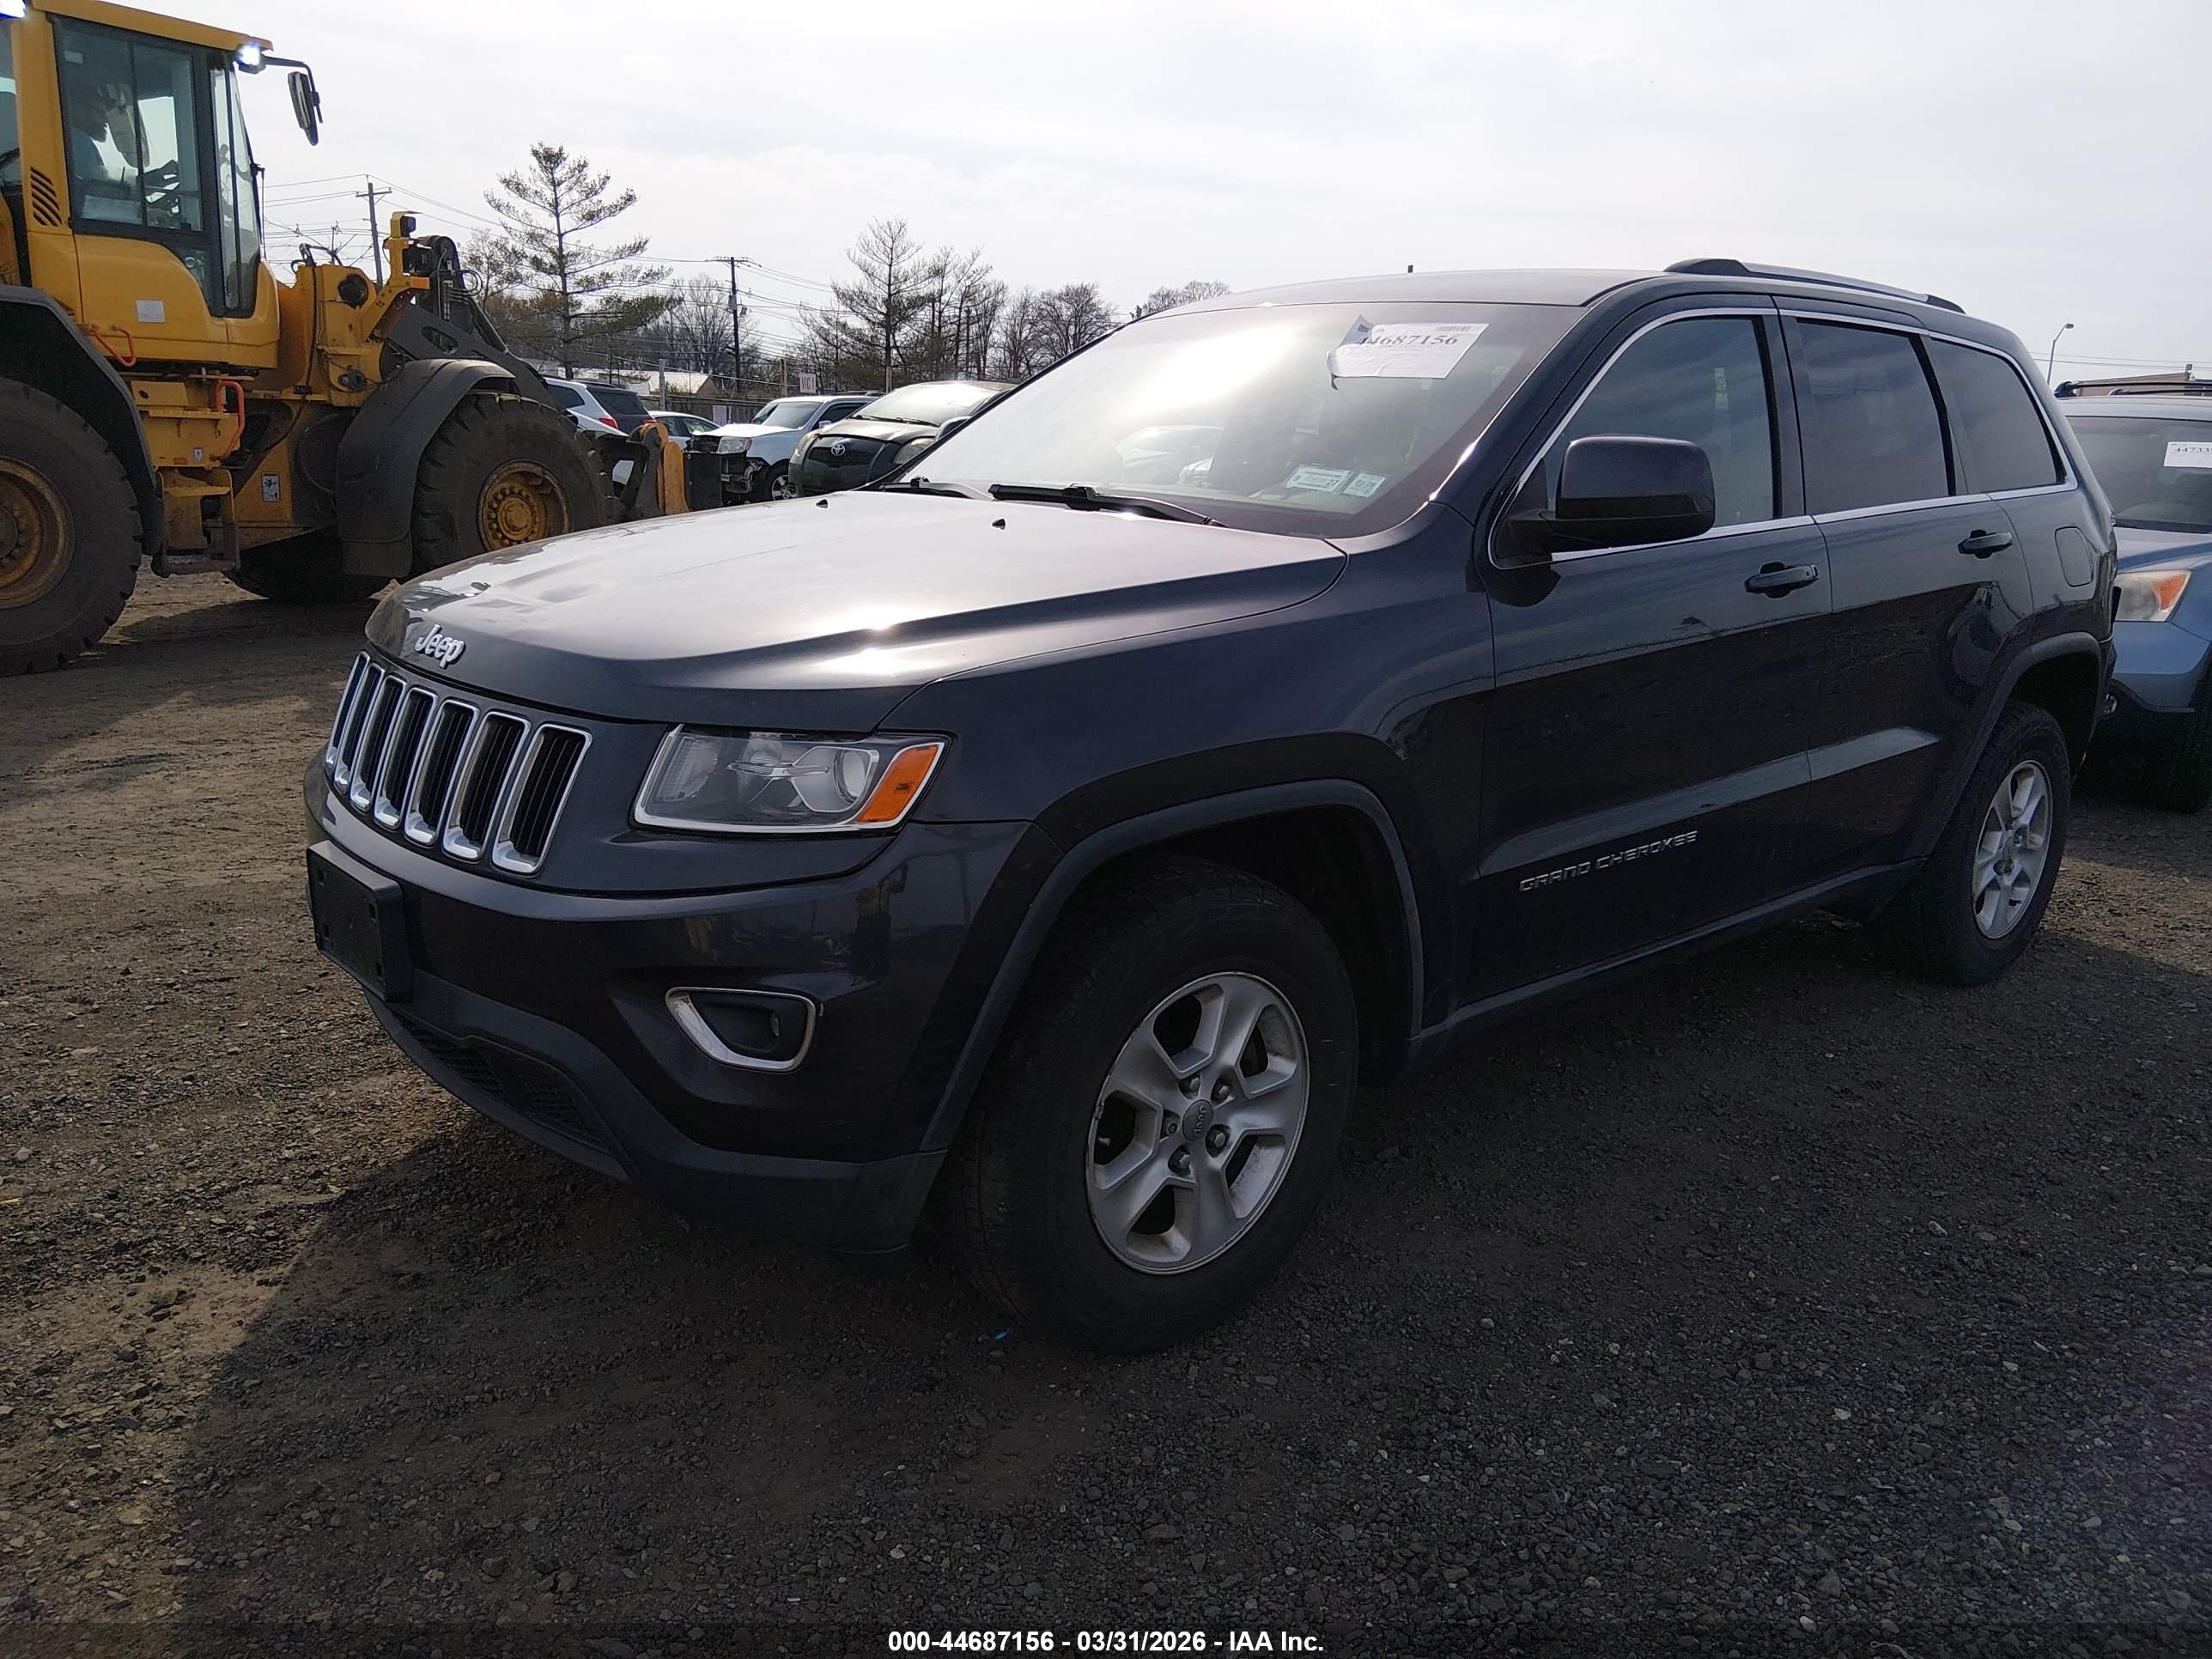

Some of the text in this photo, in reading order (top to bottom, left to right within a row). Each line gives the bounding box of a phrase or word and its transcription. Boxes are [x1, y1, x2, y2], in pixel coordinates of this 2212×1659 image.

[1354, 334, 1459, 345] 44687156
[415, 623, 465, 668] Jeep
[1518, 830, 1698, 891] GRAND CHEROKEE
